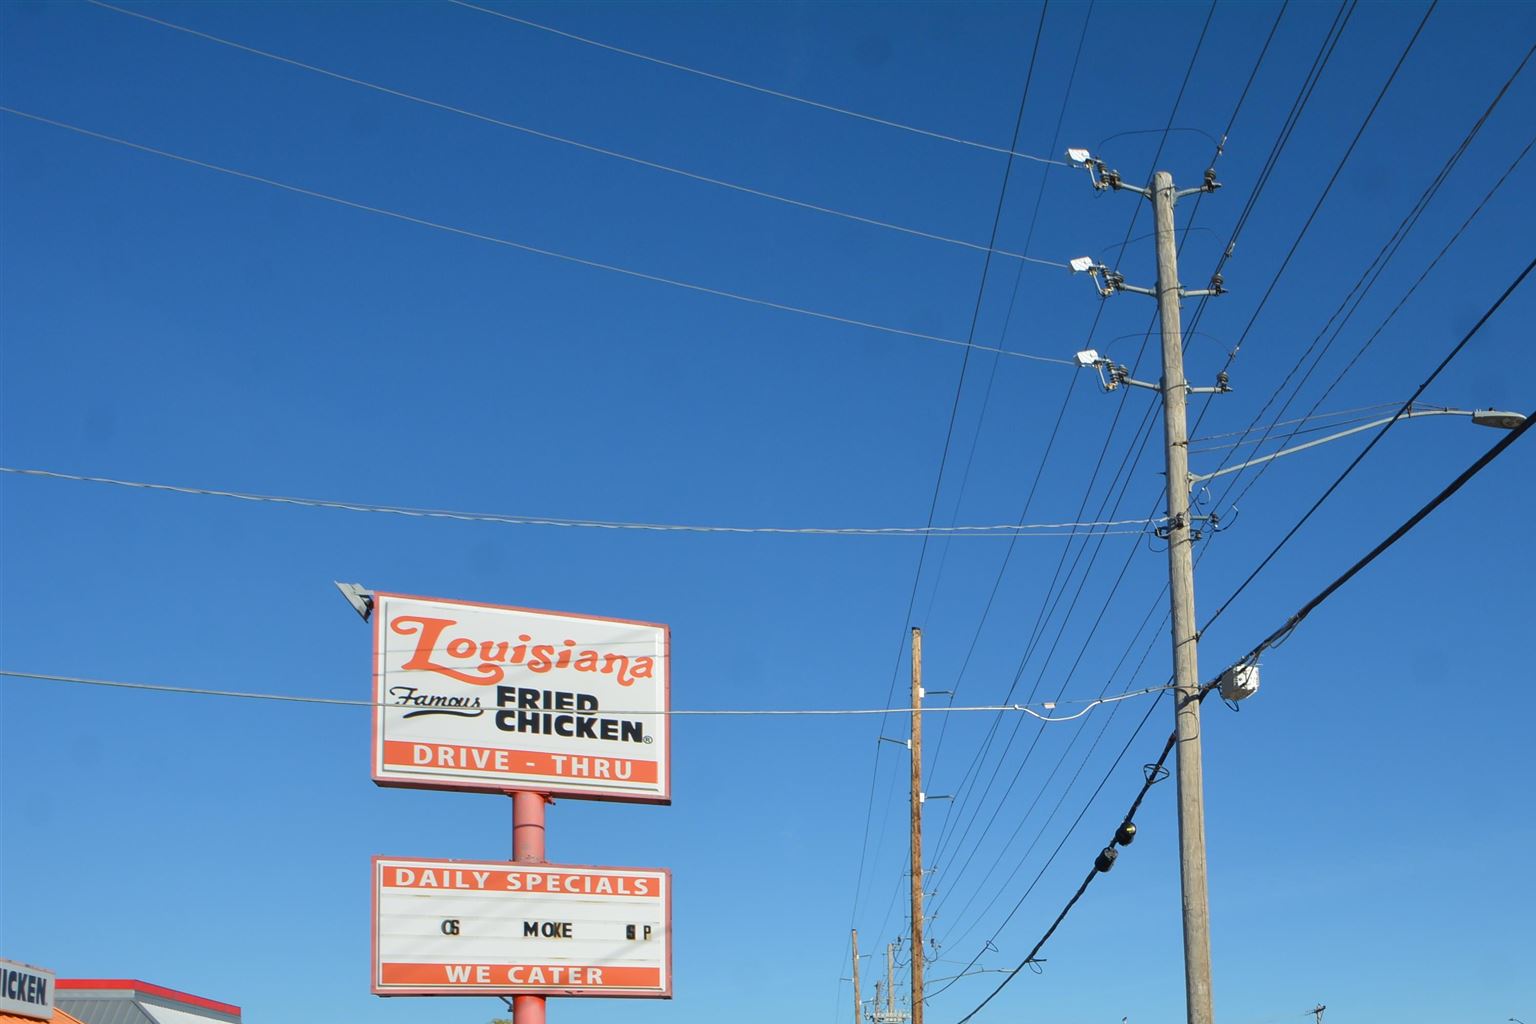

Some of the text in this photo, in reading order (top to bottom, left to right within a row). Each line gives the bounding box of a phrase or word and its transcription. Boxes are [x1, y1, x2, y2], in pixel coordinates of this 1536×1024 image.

[390, 615, 653, 687] Louisiana
[389, 686, 482, 708] Famous
[497, 685, 598, 715] FRIED
[413, 744, 509, 771] DRIVE
[551, 755, 632, 780] THRU
[395, 868, 649, 895] DAILY SPECIALS
[0, 968, 47, 1006] ICKEN
[444, 965, 603, 984] WE CATER
